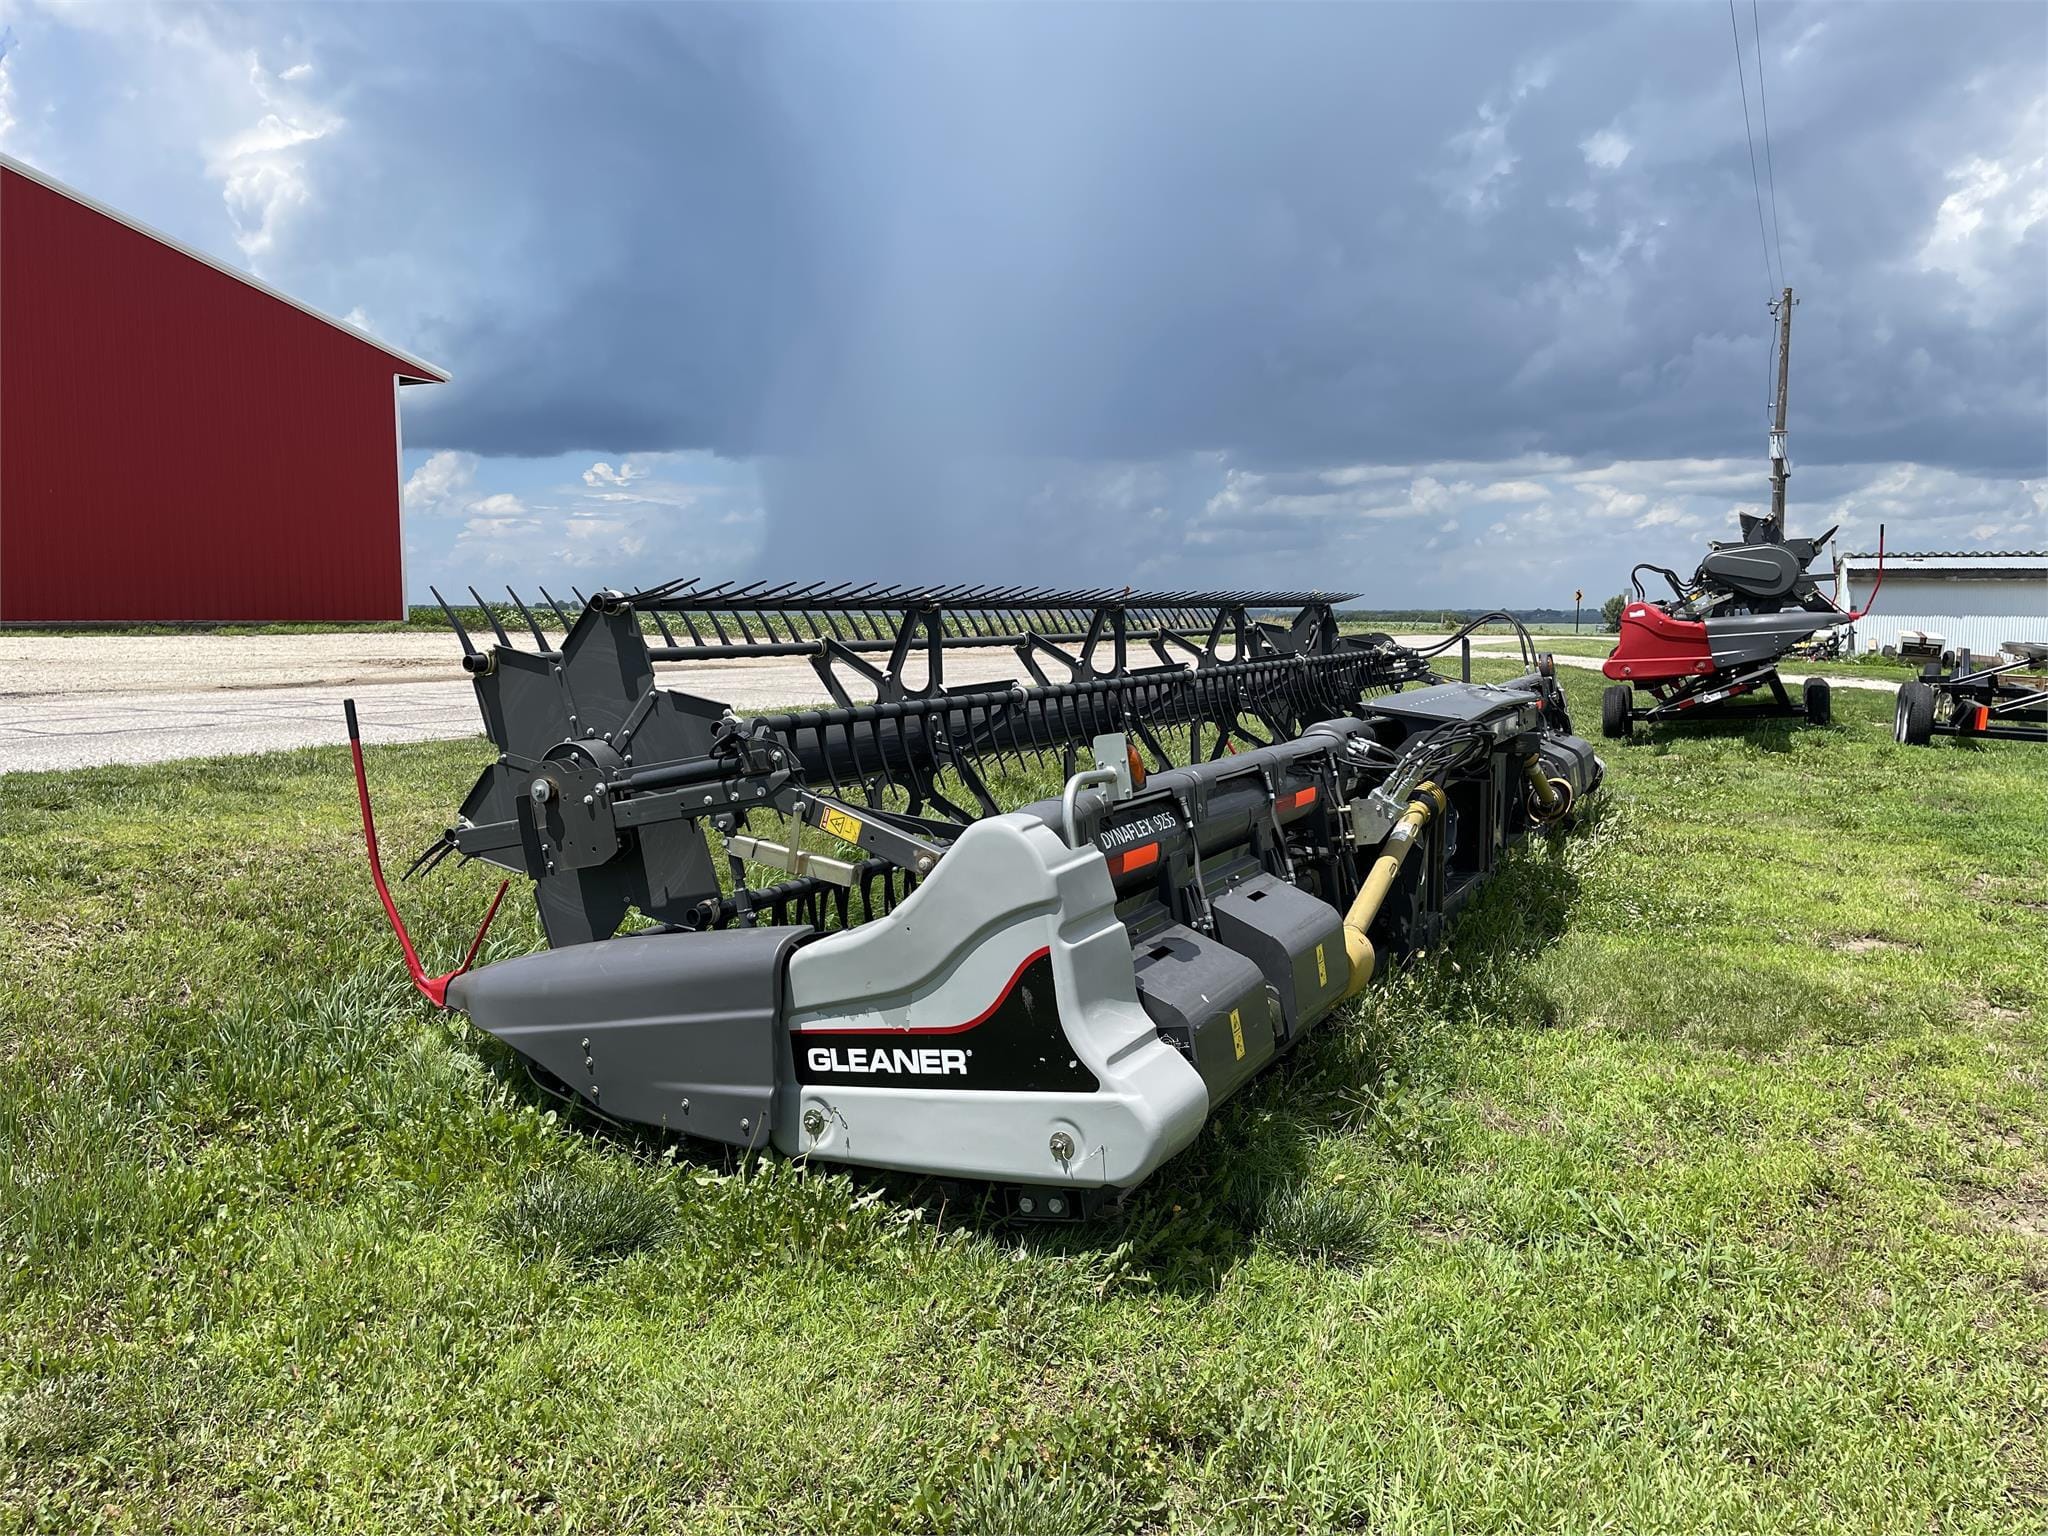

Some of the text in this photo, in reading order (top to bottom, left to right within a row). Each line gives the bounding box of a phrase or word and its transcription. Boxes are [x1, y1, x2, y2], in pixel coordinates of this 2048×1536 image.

[1100, 811, 1177, 850] DYNAFLEX 9255
[807, 1047, 968, 1075] GLEANER
